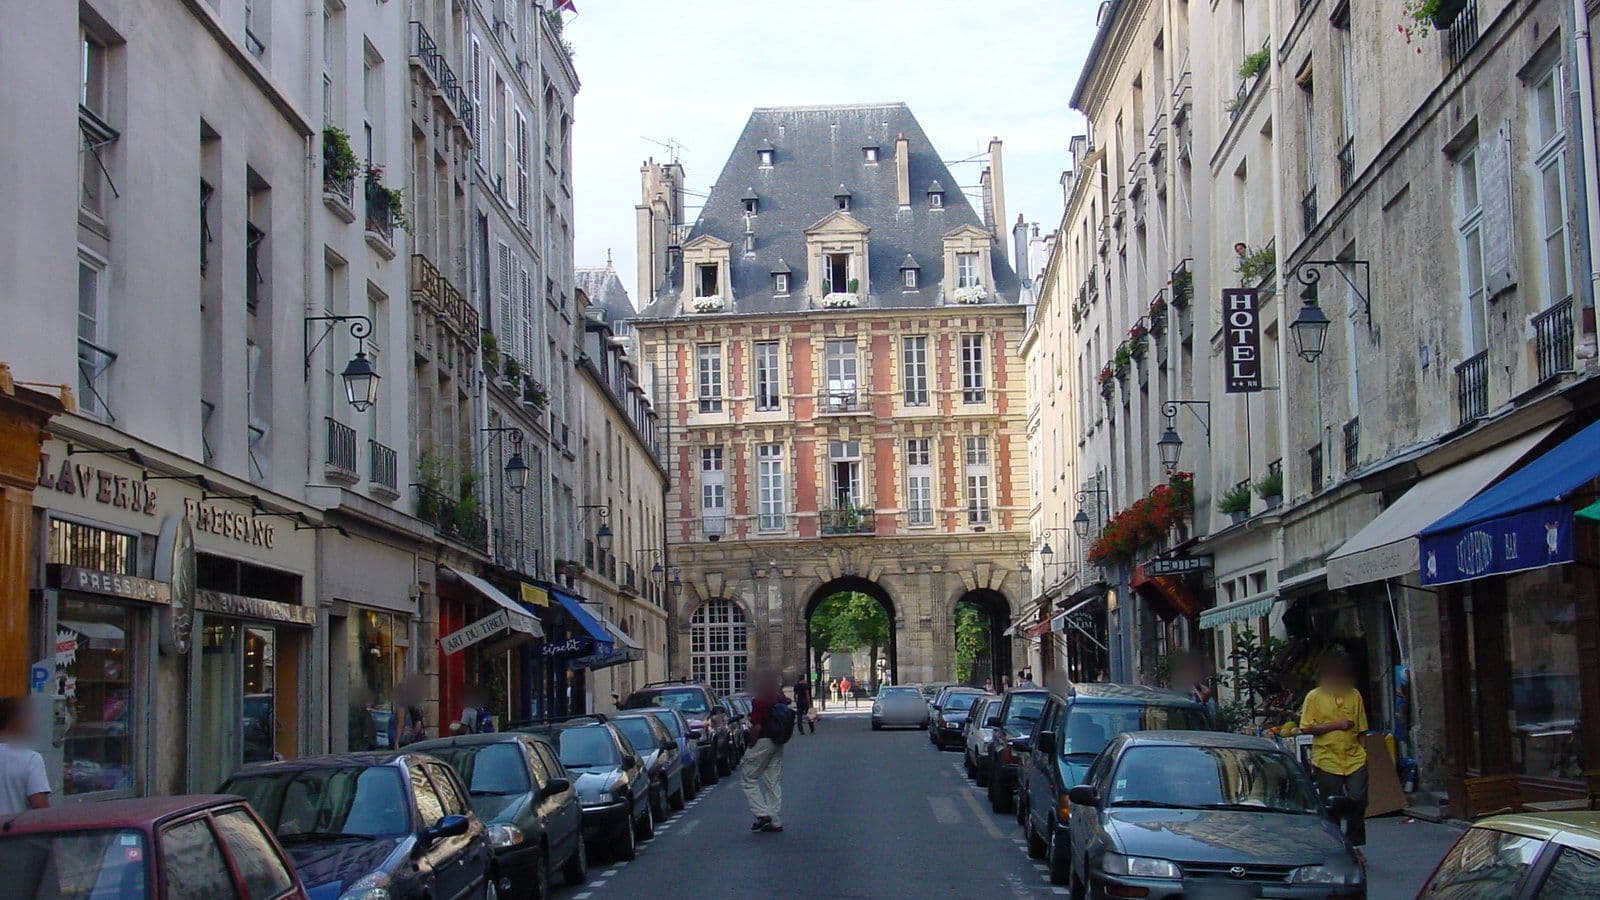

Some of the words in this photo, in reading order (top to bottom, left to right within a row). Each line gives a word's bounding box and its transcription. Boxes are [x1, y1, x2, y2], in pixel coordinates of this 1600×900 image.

[1230, 294, 1256, 379] HOTEL
[38, 452, 160, 516] LAVERIE
[184, 496, 275, 550] PRESSING
[80, 571, 156, 599] PRESSING
